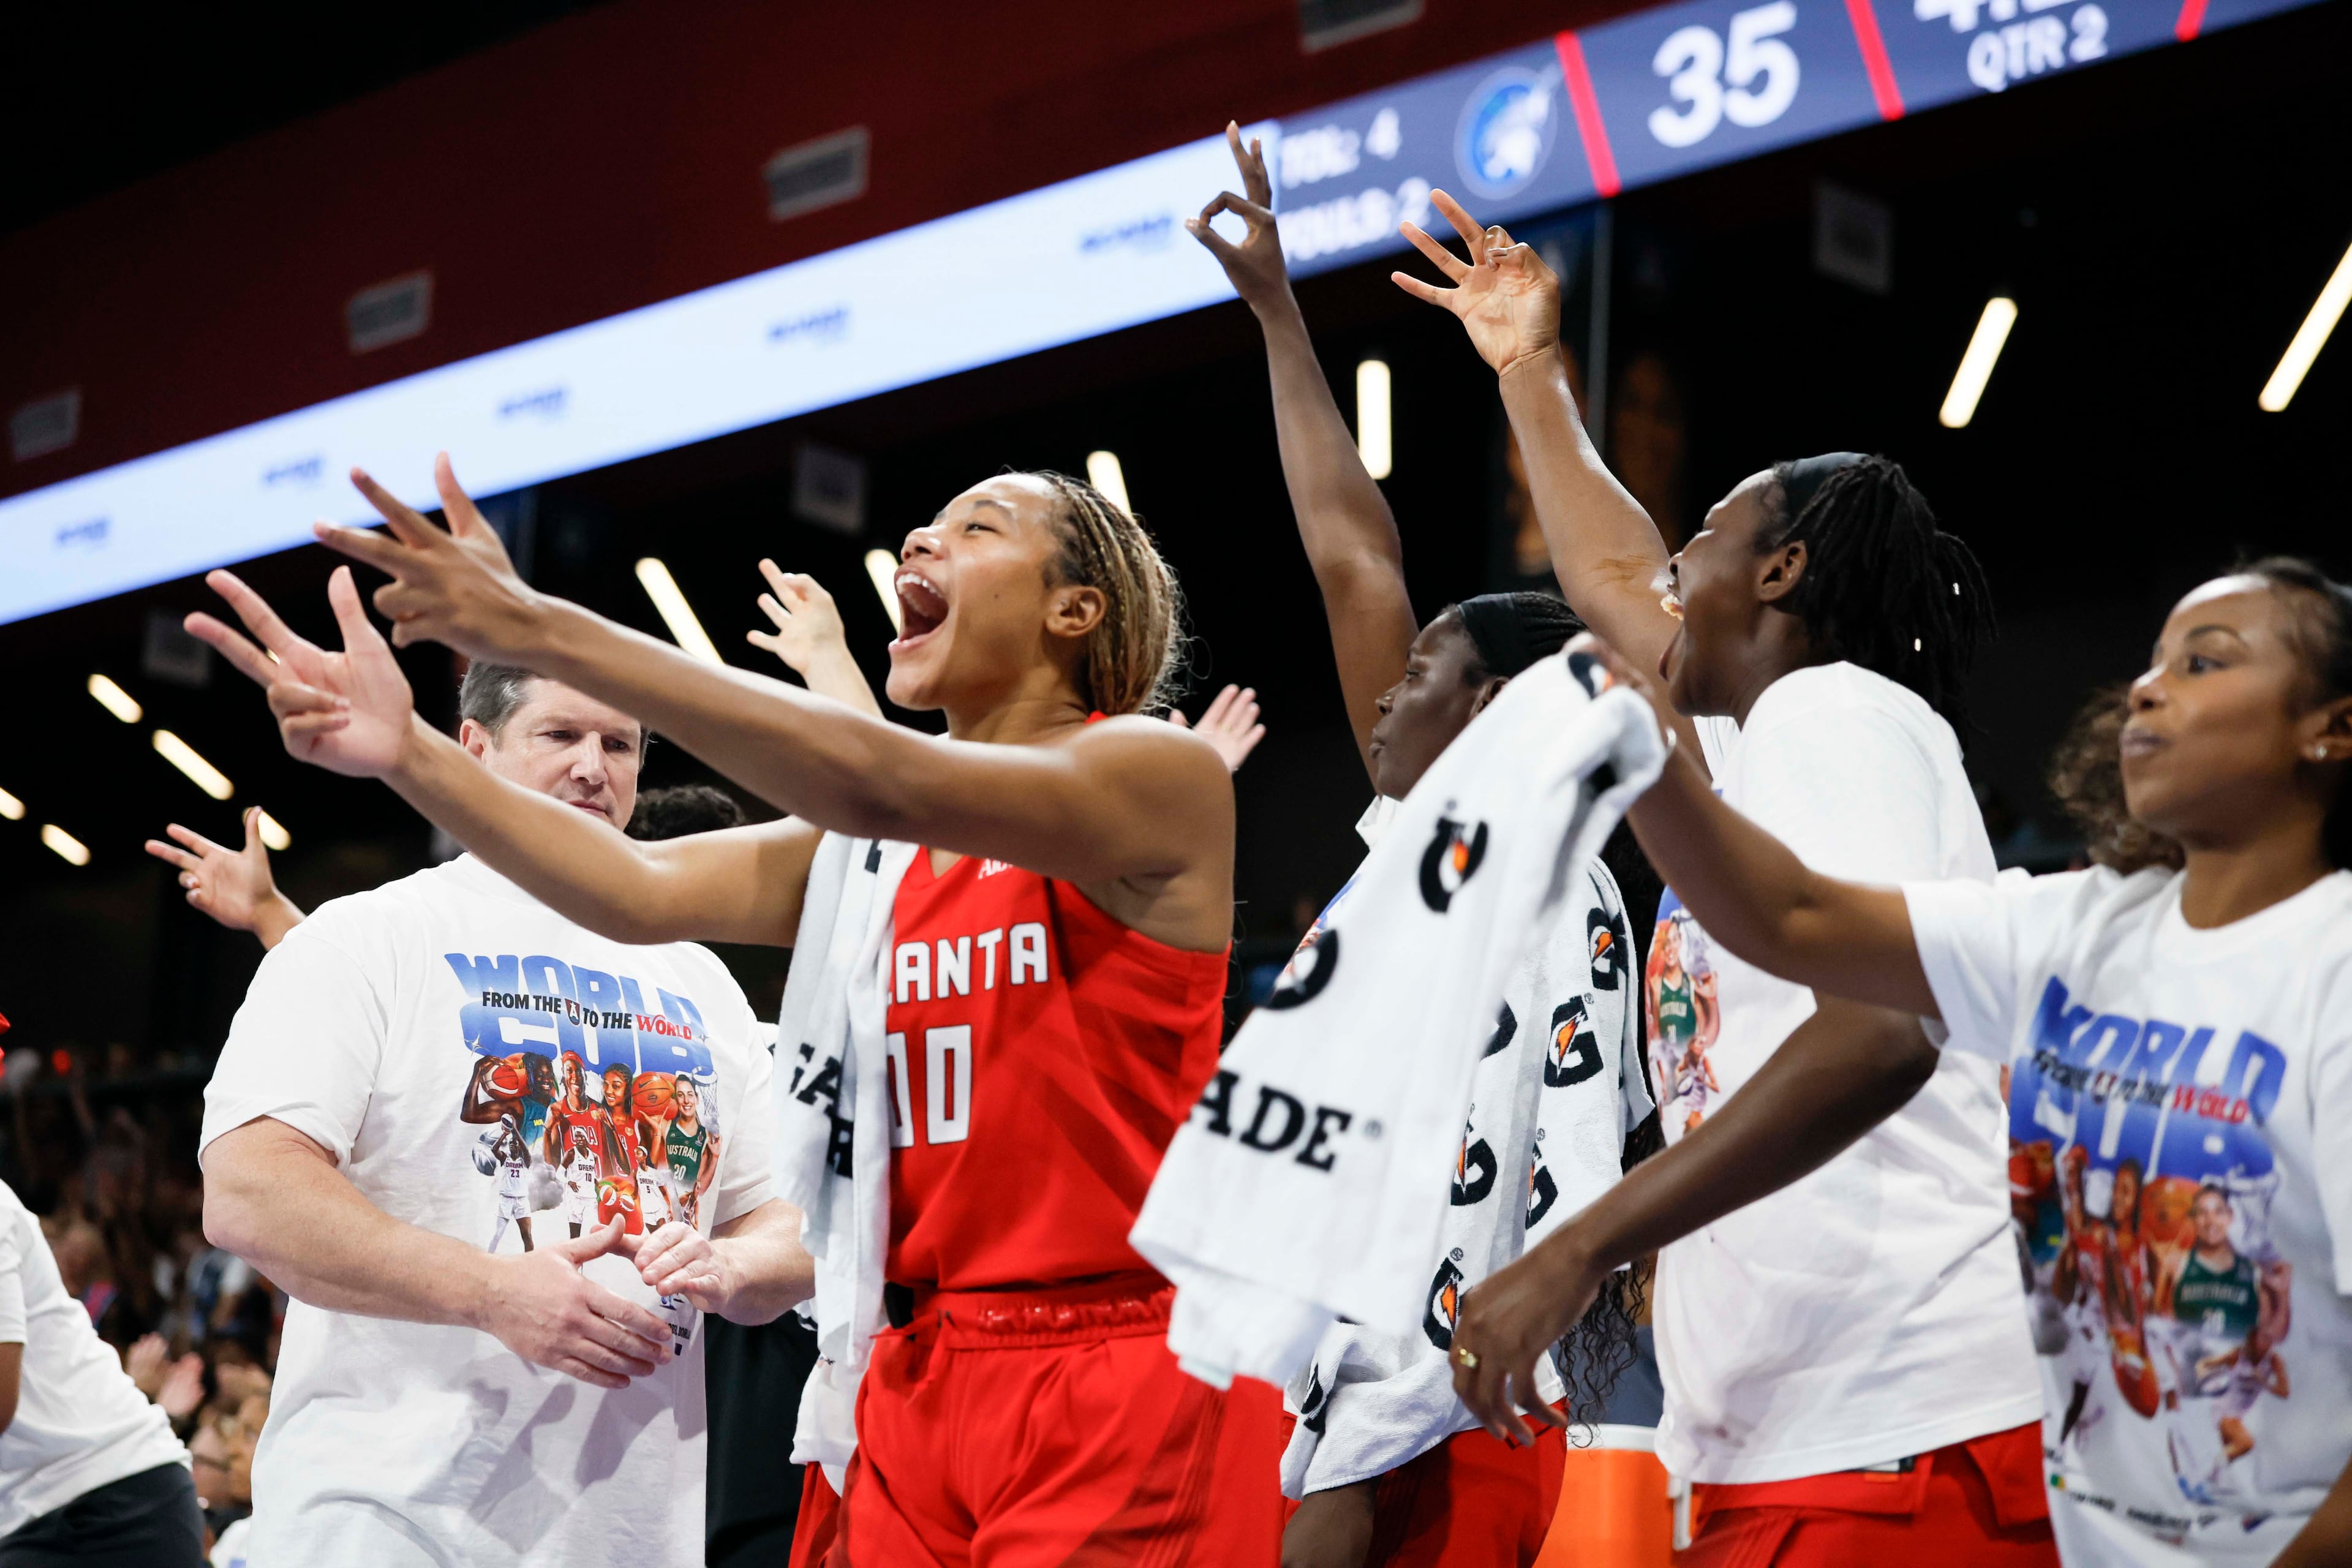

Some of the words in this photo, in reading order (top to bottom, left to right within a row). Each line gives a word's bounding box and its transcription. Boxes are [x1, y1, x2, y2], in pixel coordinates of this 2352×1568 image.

[1967, 15, 2067, 92] QTR
[2069, 3, 2108, 62] 2
[1649, 1, 1800, 148] 35
[1366, 107, 1402, 160] 4
[888, 922, 1048, 1005] ANTA
[444, 952, 706, 1035] WORLD
[483, 991, 529, 1010] FROM
[533, 995, 562, 1014] THE
[582, 1008, 598, 1028] TO
[602, 1012, 631, 1029] THE
[635, 1014, 692, 1040] WORLD
[570, 1126, 598, 1146] UA
[511, 1169, 519, 1178] 23
[586, 1173, 592, 1182] 10
[646, 1185, 650, 1194] 5
[674, 1164, 687, 1181] 20
